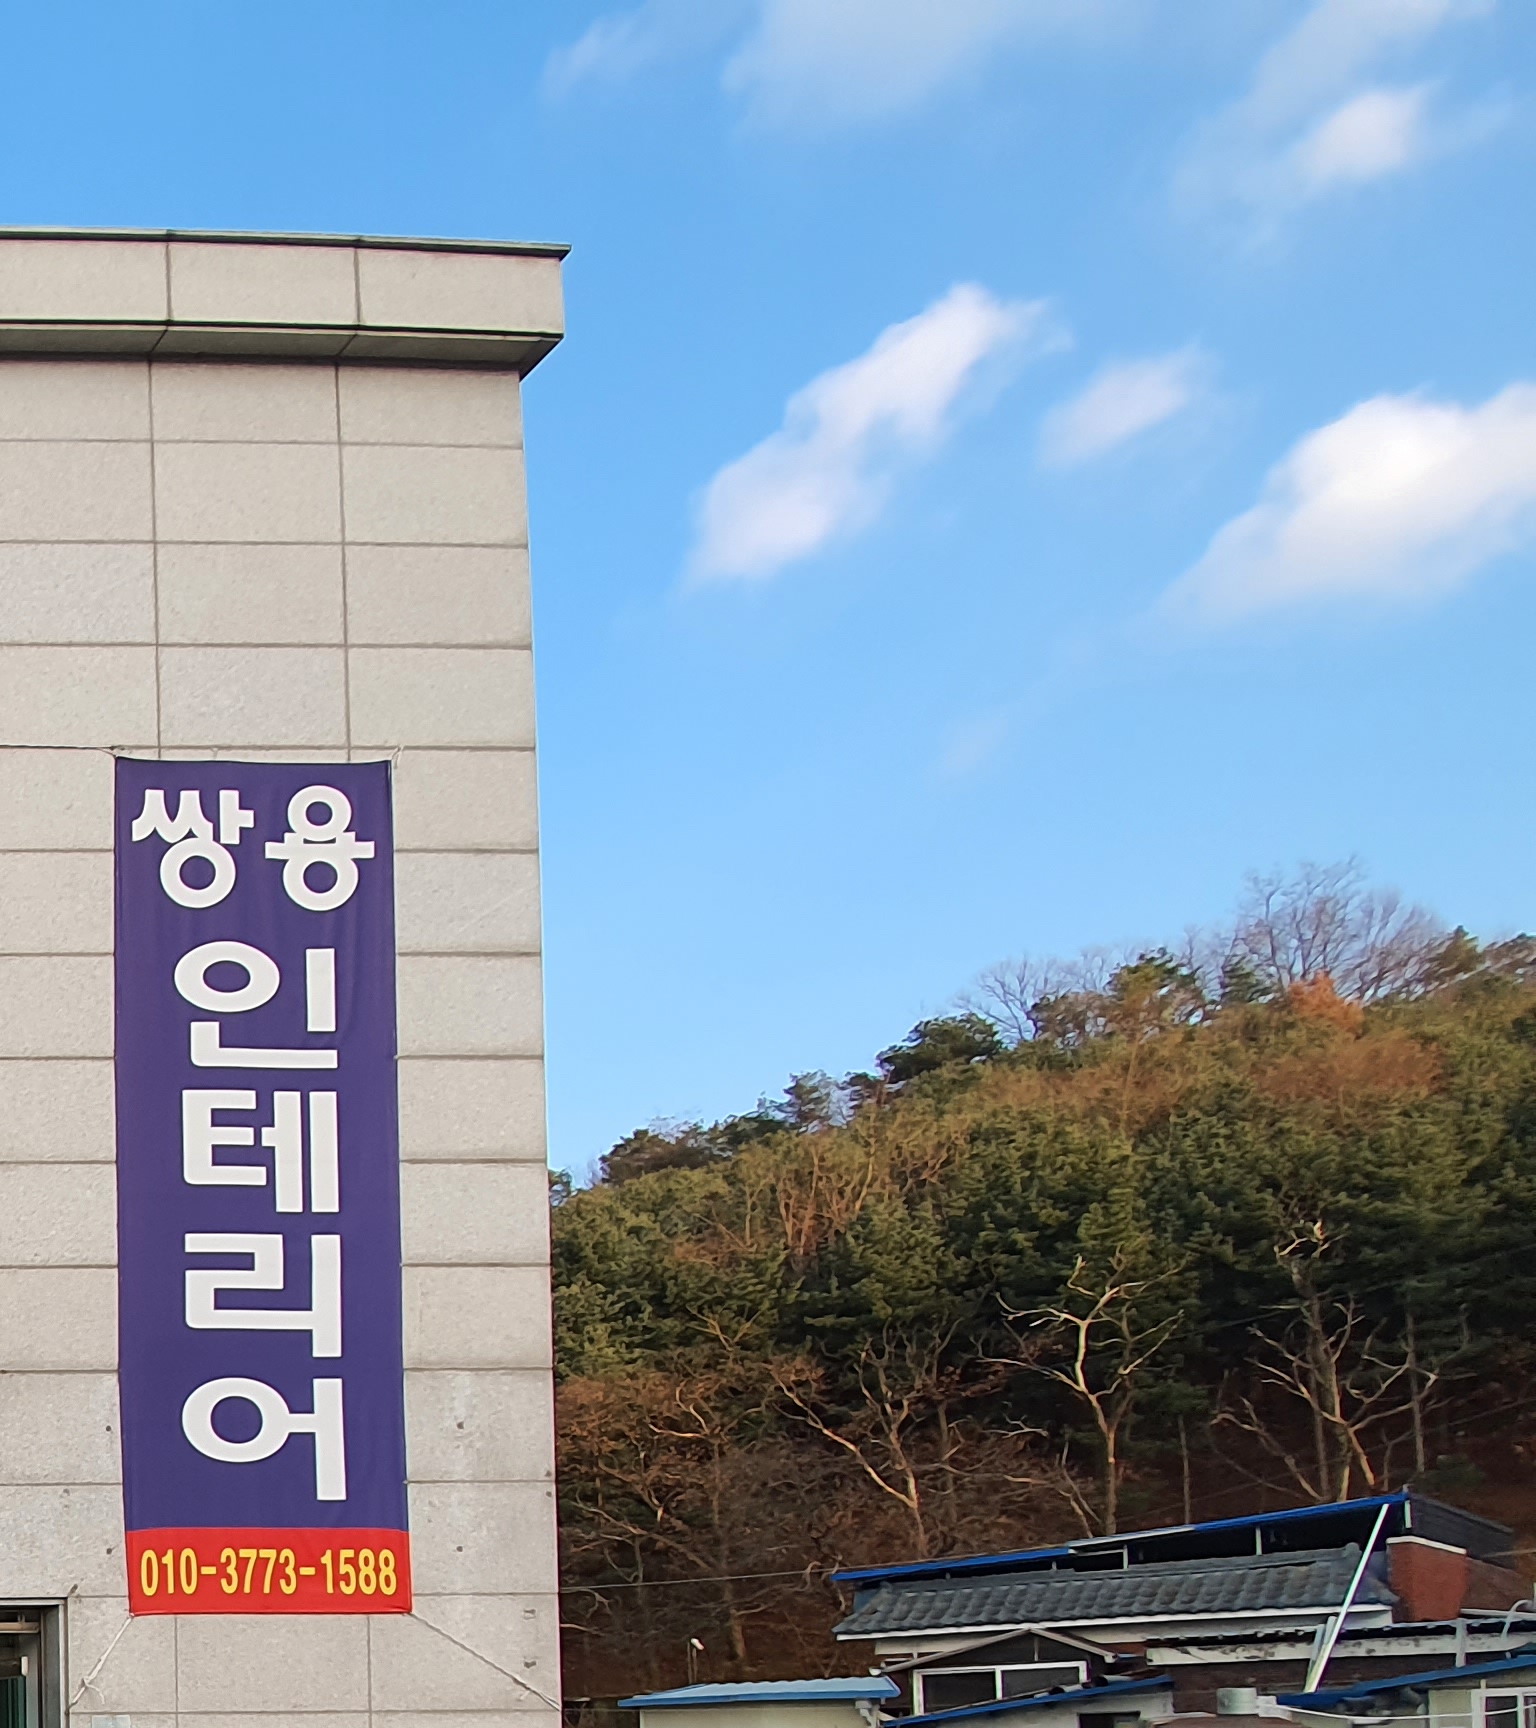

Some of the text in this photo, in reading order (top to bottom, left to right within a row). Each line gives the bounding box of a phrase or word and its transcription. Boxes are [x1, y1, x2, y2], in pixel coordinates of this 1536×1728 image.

[131, 784, 375, 912] 쌍용
[173, 940, 348, 1501] 인테리어
[140, 1547, 398, 1596] 010-3773-1588
